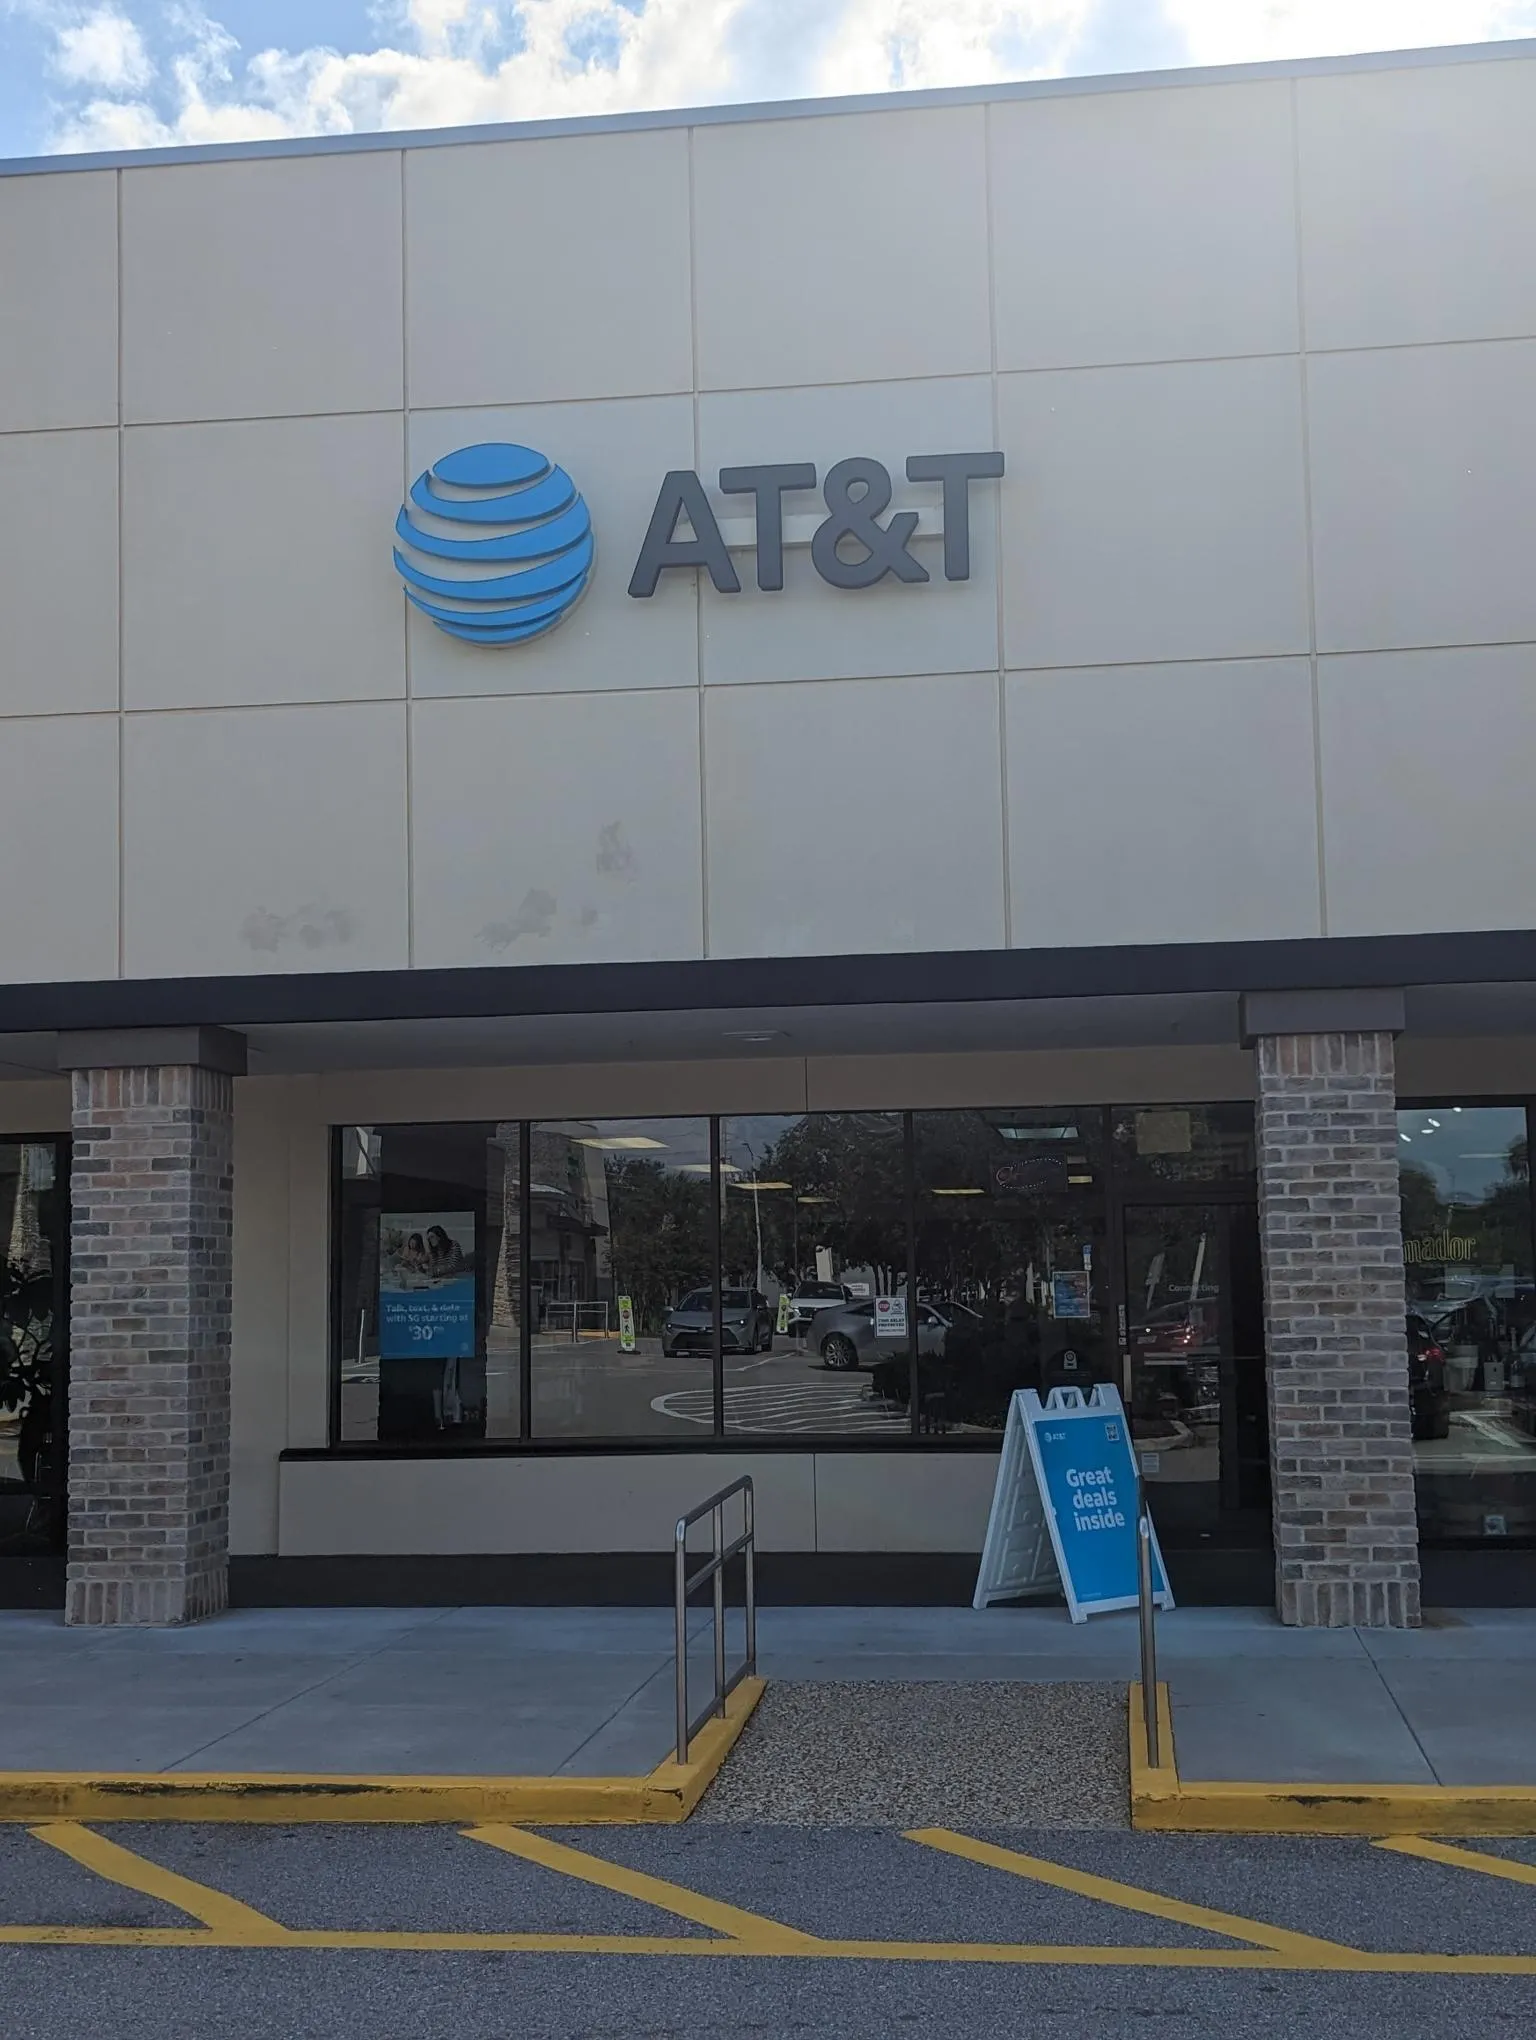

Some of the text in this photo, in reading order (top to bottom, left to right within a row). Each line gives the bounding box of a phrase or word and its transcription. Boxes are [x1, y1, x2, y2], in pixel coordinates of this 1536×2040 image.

[628, 452, 1005, 598] AT&T
[1168, 1284, 1220, 1295] Connting
[385, 1313, 469, 1323] with 5G starting at
[1066, 1466, 1114, 1487] Great
[1073, 1487, 1118, 1509] deals
[1074, 1508, 1126, 1532] inside
